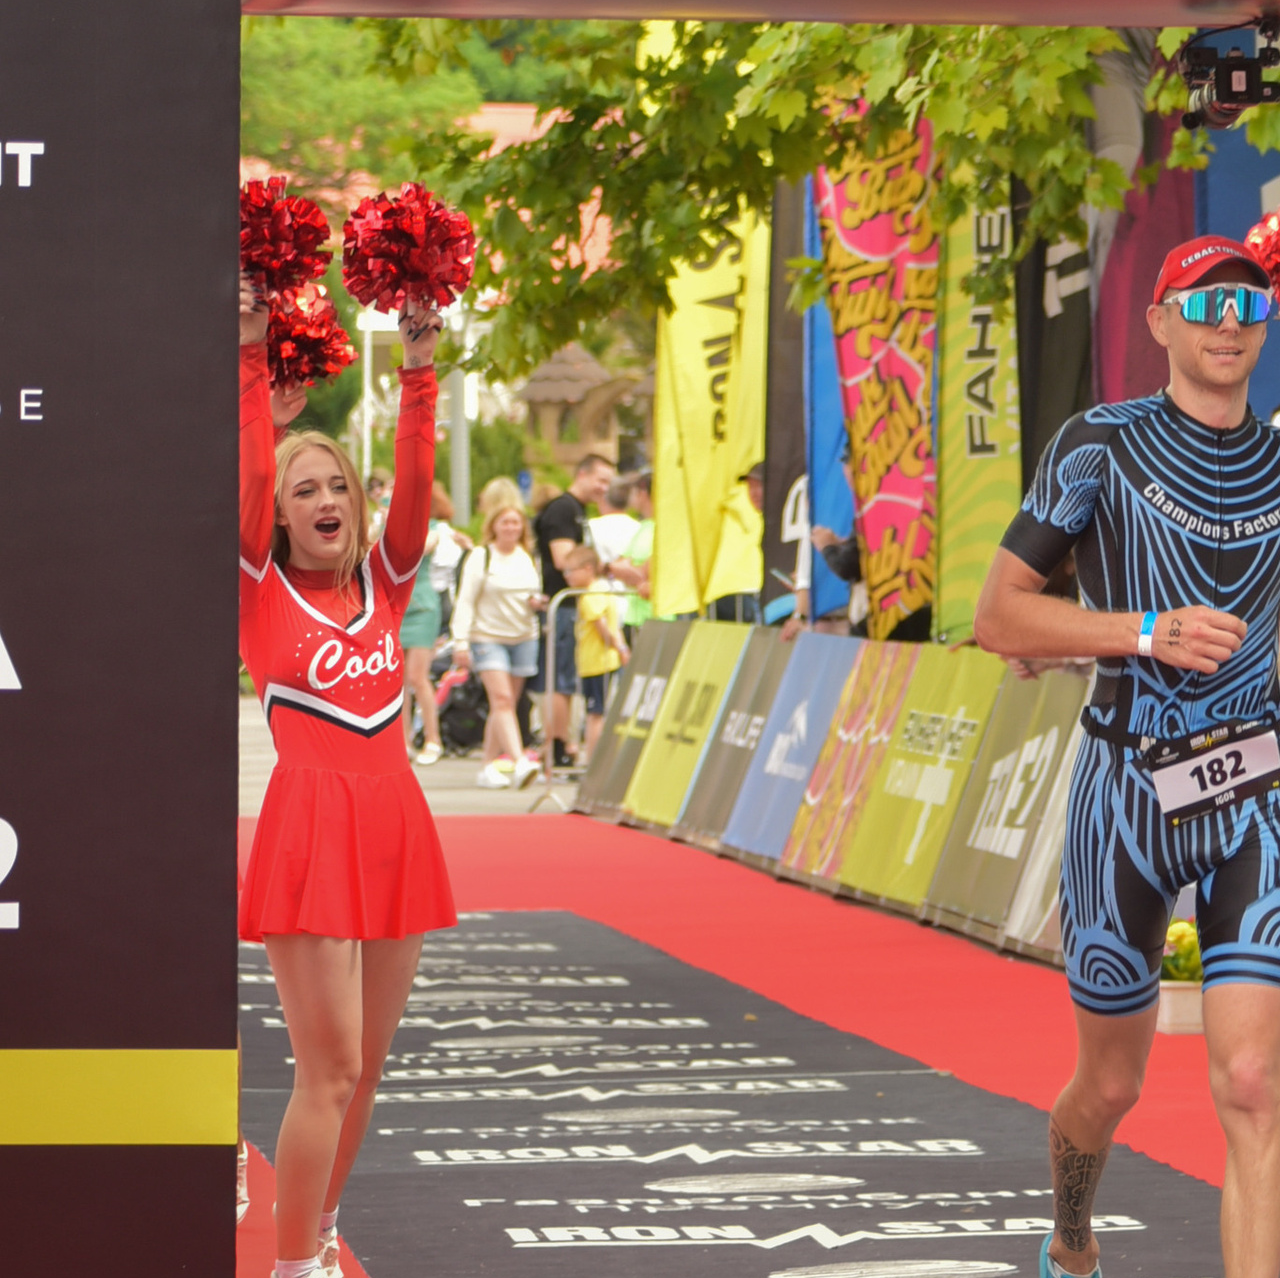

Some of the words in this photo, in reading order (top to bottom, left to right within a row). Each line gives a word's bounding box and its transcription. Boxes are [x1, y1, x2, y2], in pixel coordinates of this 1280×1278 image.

[1143, 482, 1230, 540] Champions
[307, 632, 400, 691] Cool
[1188, 750, 1247, 793] 182
[1214, 789, 1236, 807] IGOR
[413, 1145, 637, 1161] IRON
[745, 1138, 979, 1153] STAR
[504, 1225, 756, 1243] IRON
